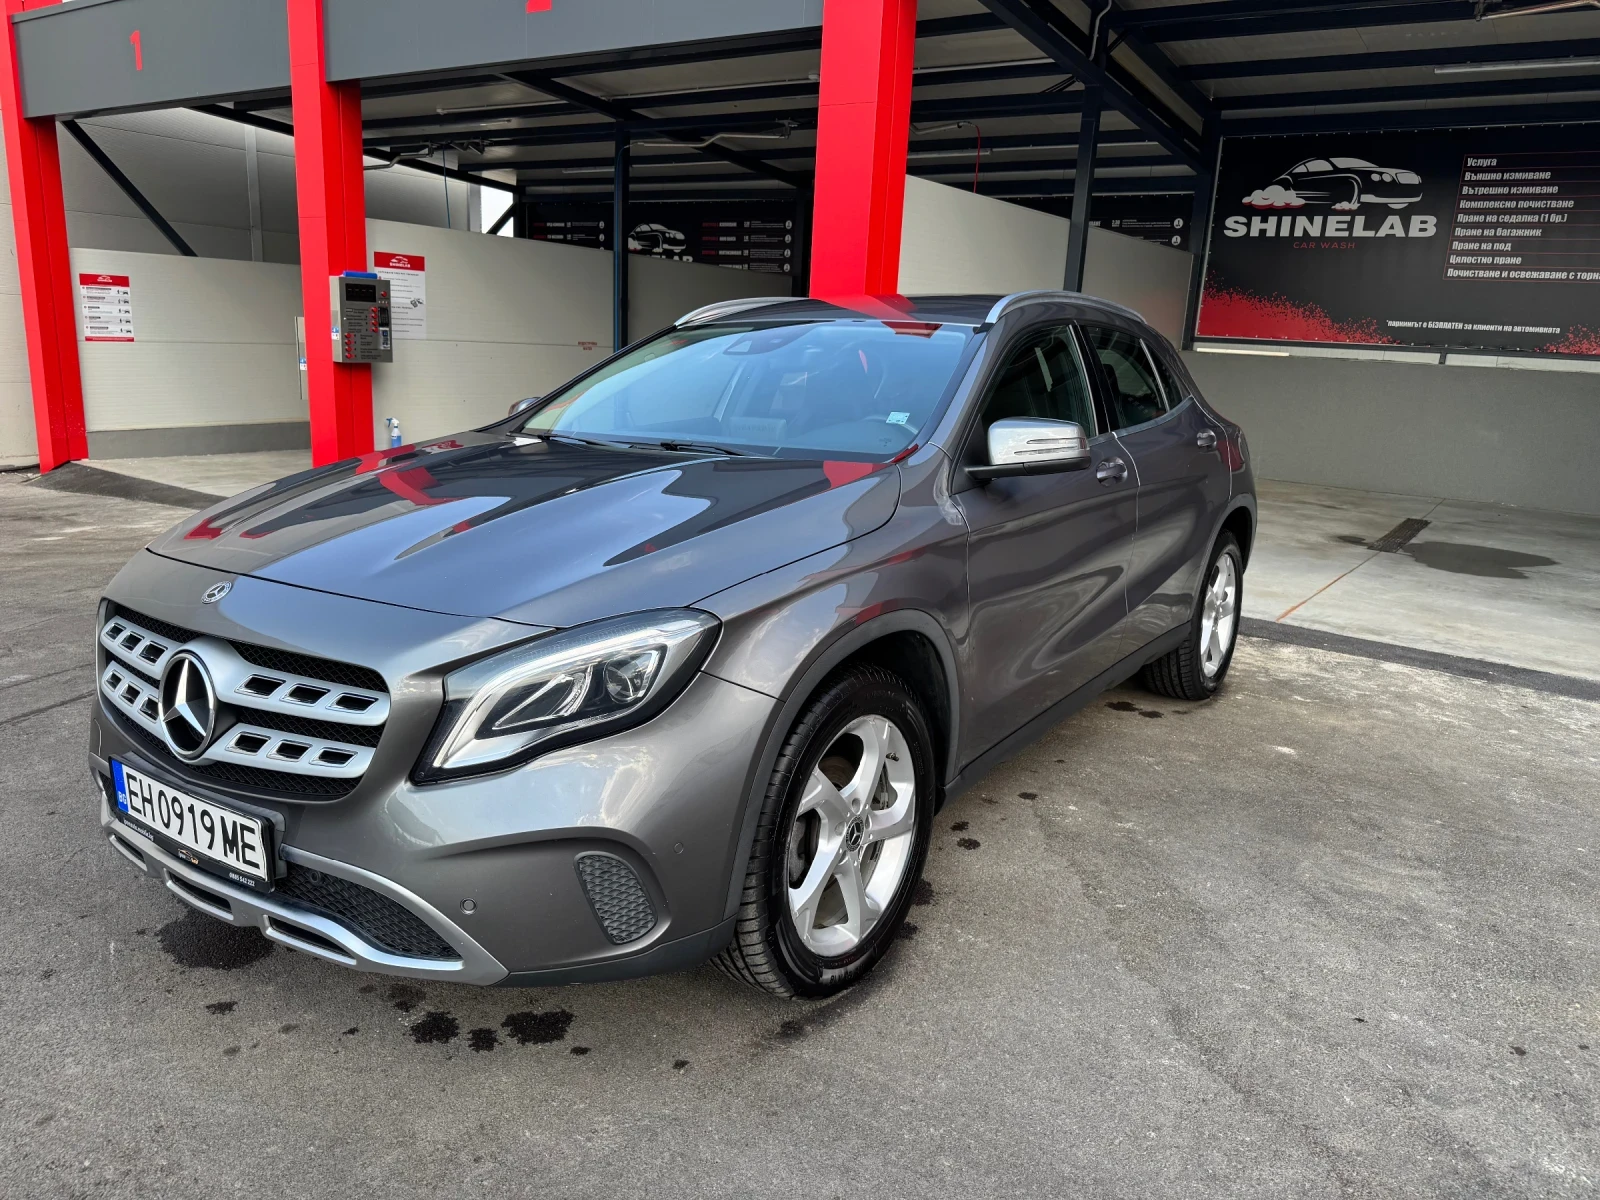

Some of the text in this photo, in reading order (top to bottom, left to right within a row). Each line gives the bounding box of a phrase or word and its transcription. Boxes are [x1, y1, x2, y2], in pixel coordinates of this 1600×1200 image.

[129, 30, 143, 71] 1
[1467, 157, 1497, 167] Услуга
[1464, 171, 1551, 180] Външно измиване
[1462, 186, 1558, 195] Вътрешно измиване
[1459, 200, 1574, 208] Комплексно почистване
[1457, 213, 1485, 223] Пране
[1499, 214, 1539, 223] седалка
[1223, 215, 1438, 238] SHINELAB
[1455, 227, 1542, 237] Пране на багажник
[1293, 241, 1316, 249] CAR
[1452, 241, 1512, 251] Пране на под
[1449, 255, 1522, 265] Цялостно пране
[1447, 268, 1501, 278] Почистване
[1501, 269, 1508, 278] и
[1509, 270, 1568, 279] освежаване
[1569, 271, 1575, 280] с
[1428, 321, 1463, 330] БЕЗПЛАТЕН
[1513, 325, 1561, 334] автомивката
[118, 791, 128, 805] BG
